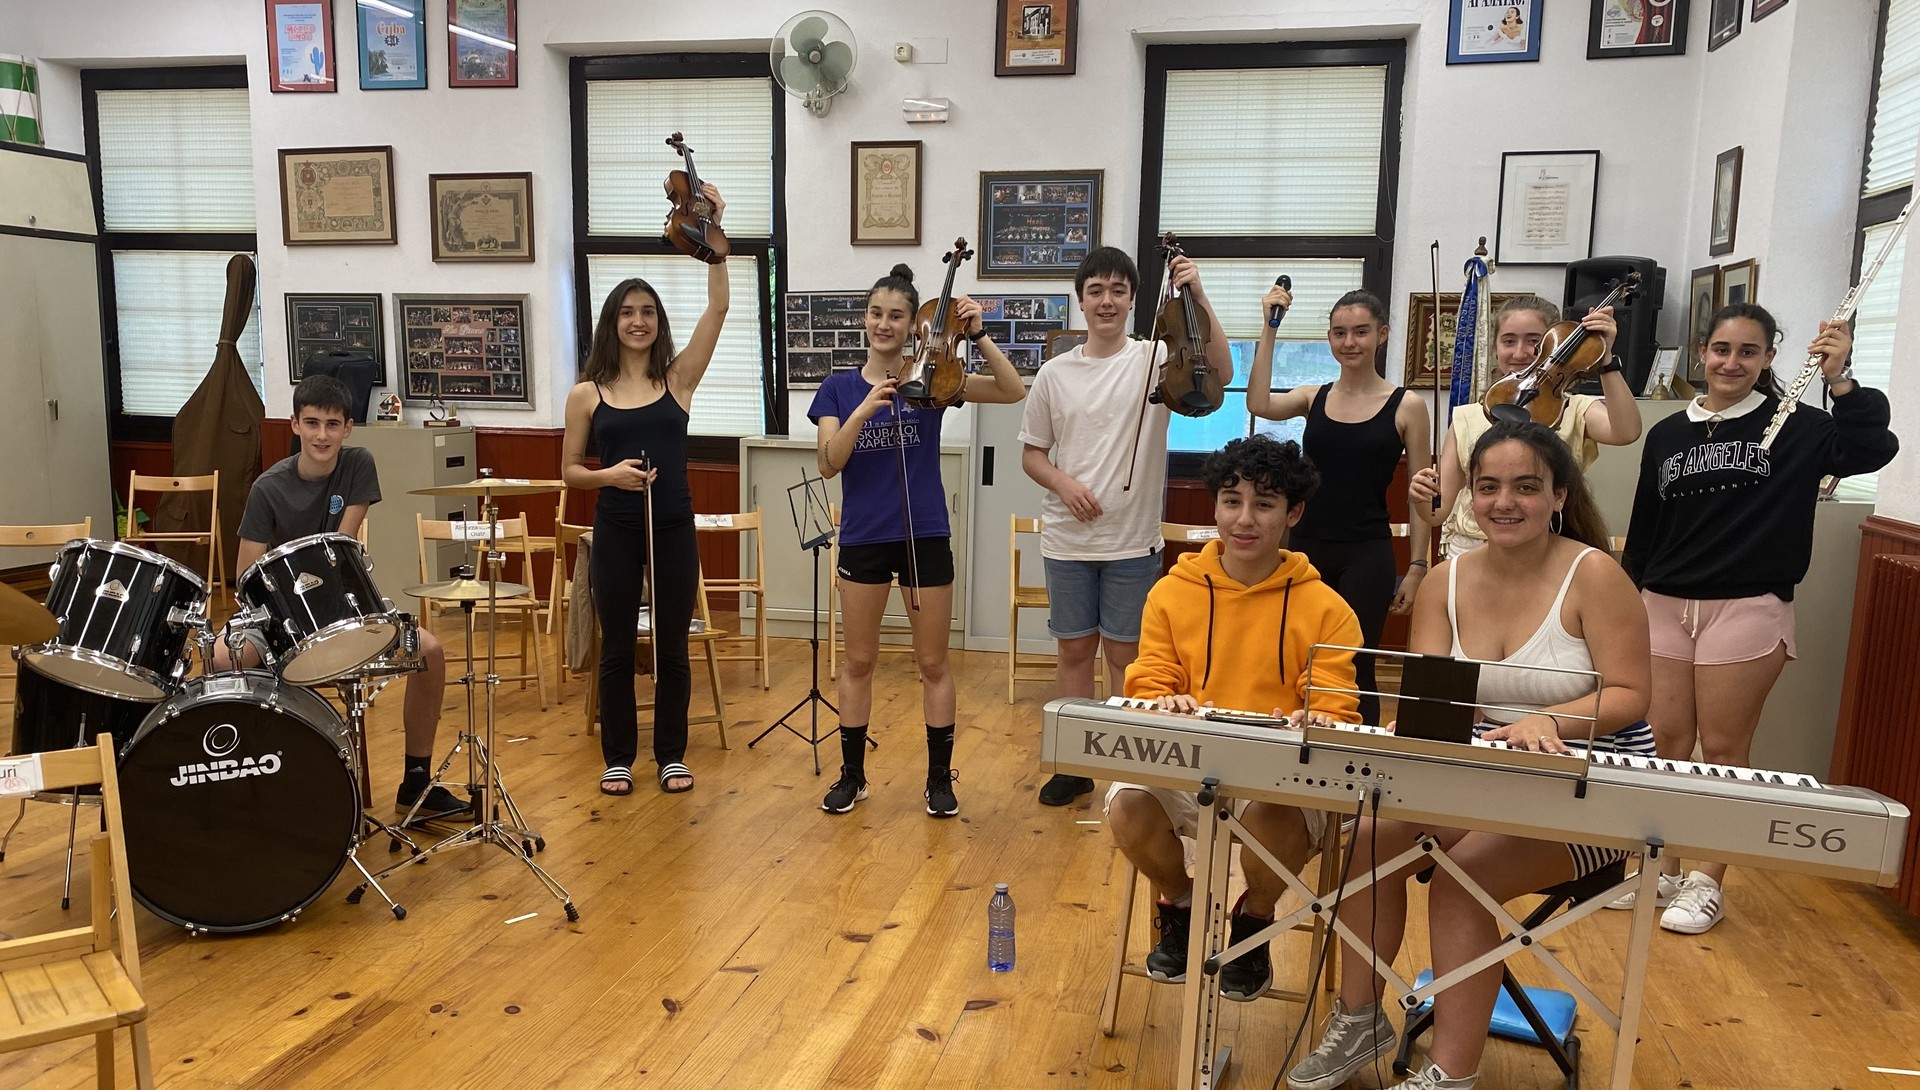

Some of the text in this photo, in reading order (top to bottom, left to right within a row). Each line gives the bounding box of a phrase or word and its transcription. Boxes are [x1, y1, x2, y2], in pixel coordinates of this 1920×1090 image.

[376, 21, 406, 36] Cuba
[858, 424, 918, 441] SKUBAOI
[1683, 440, 1771, 477] ANGELES
[1662, 479, 1759, 500] CALIFORNIA
[1083, 730, 1202, 769] KAWAI
[170, 753, 282, 787] JINBAO
[1768, 819, 1847, 853] ES6
